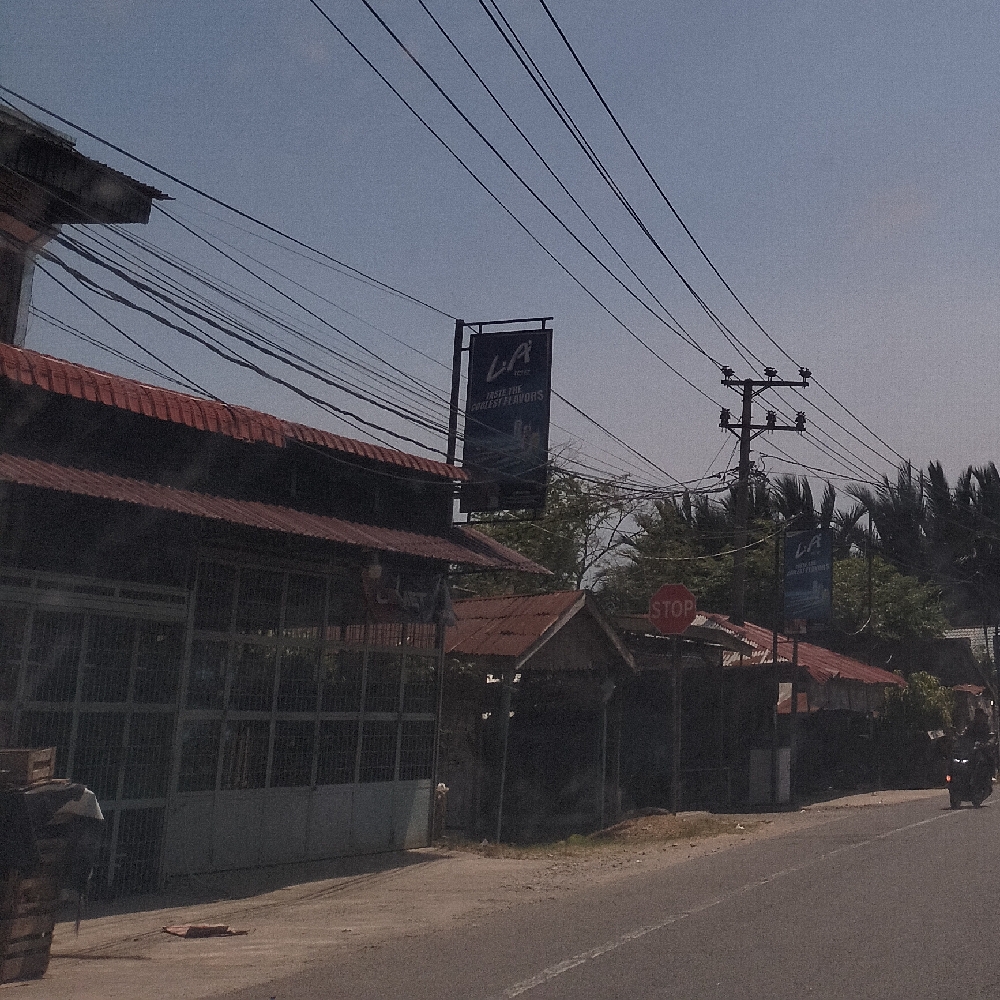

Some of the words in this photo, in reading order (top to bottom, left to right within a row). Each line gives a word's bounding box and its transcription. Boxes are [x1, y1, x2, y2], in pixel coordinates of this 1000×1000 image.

[503, 389, 544, 406] FLAVORS
[508, 385, 523, 396] THE
[652, 600, 693, 619] STOP
